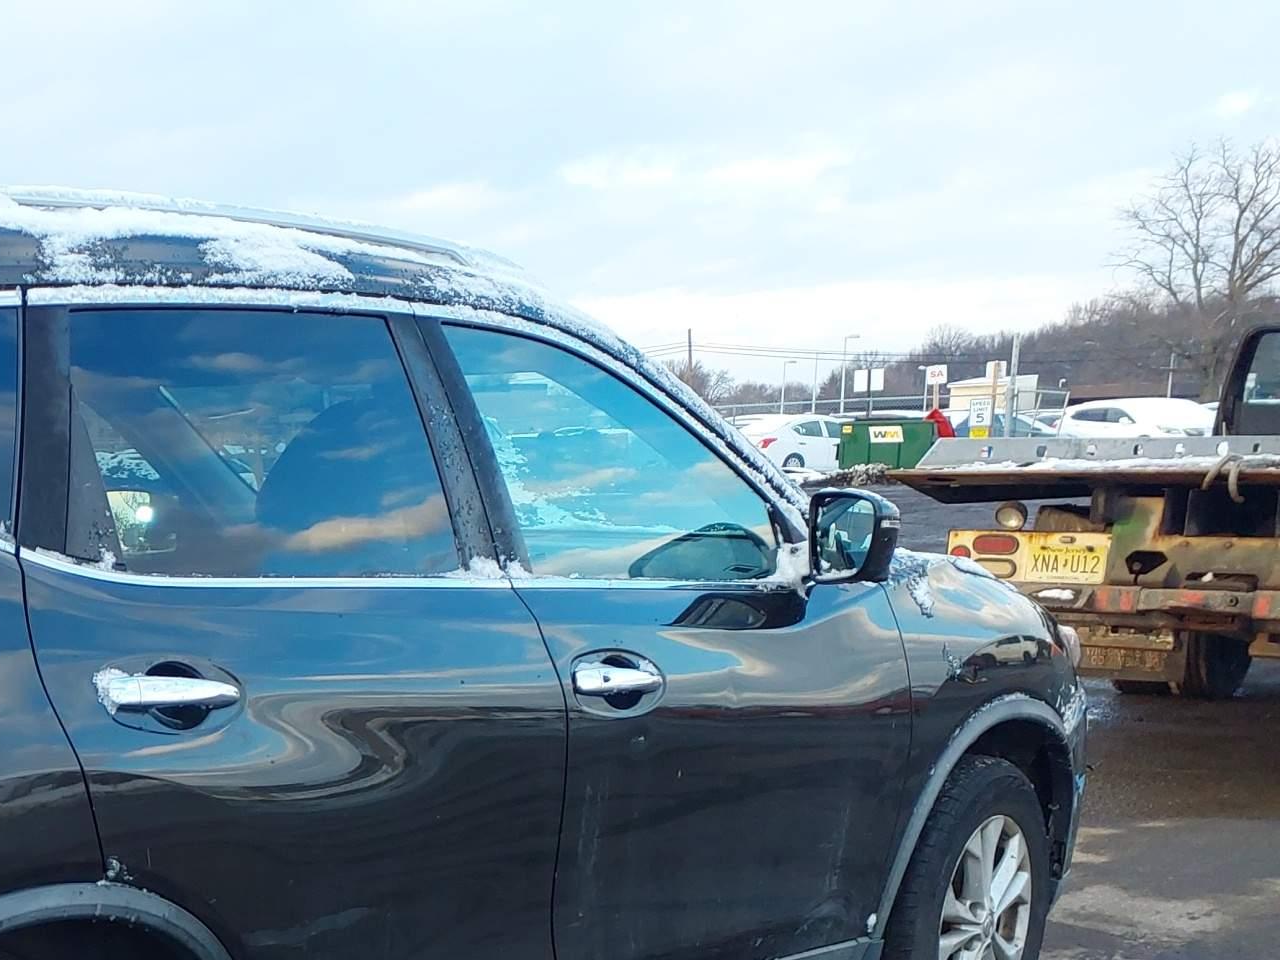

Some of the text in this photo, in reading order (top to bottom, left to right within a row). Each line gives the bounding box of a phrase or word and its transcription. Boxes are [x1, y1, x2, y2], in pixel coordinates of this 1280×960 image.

[930, 370, 944, 378] SA
[975, 412, 985, 424] 5
[1031, 554, 1101, 574] XNA U12
